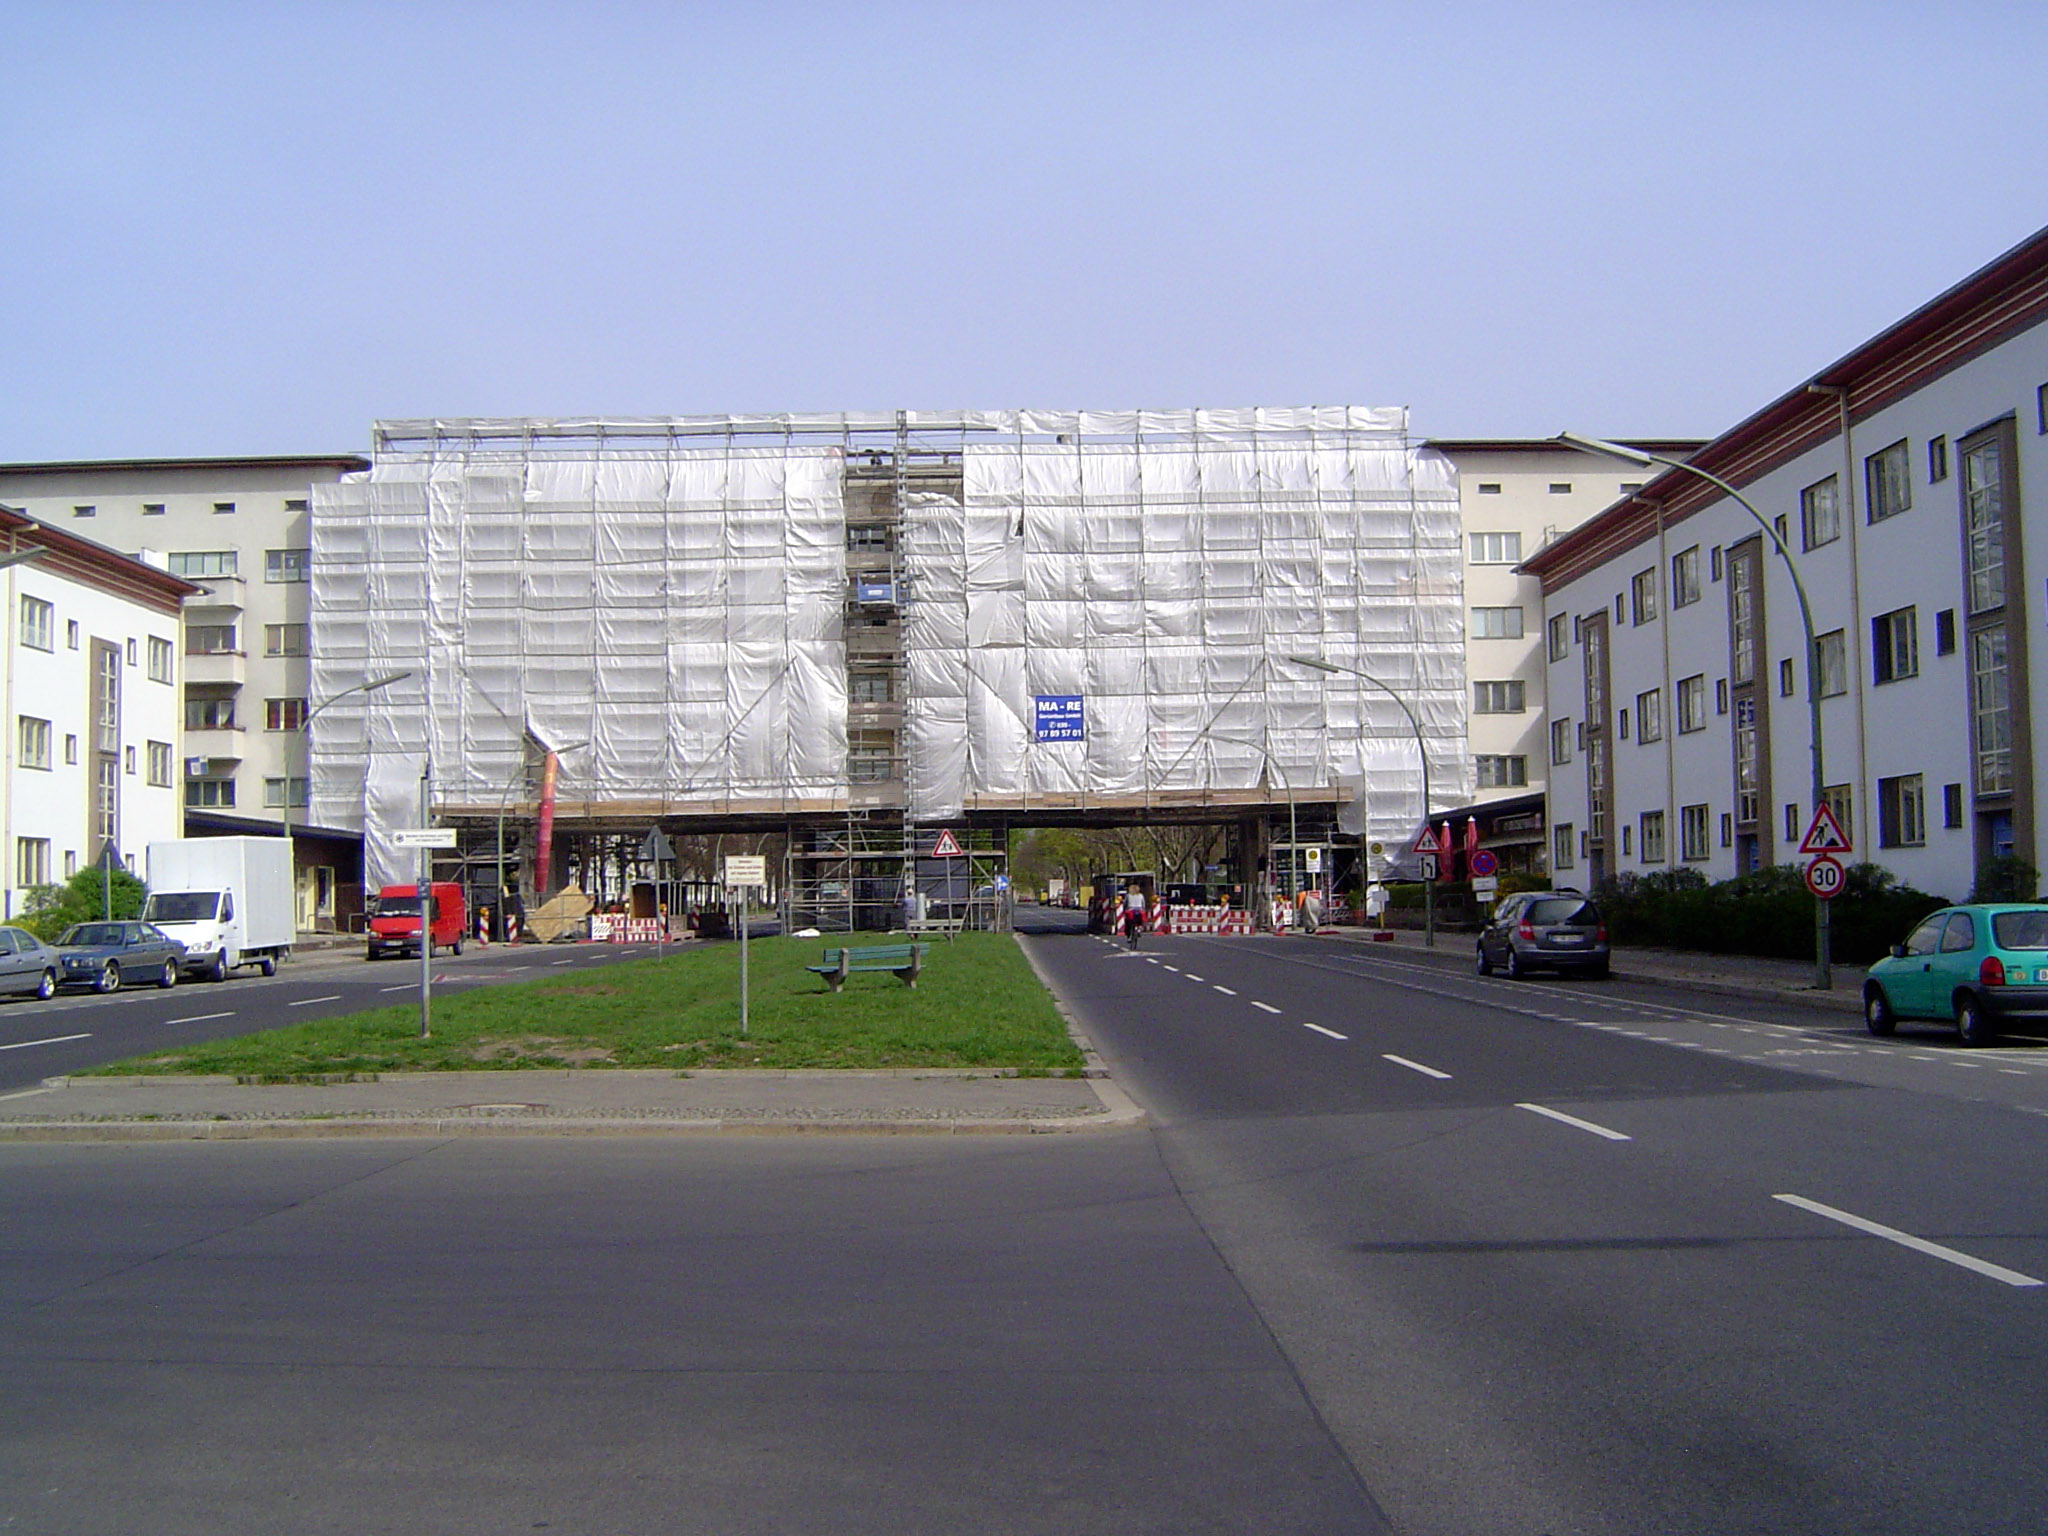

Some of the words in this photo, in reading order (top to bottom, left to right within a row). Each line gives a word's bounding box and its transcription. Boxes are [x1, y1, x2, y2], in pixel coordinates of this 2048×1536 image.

[1038, 701, 1058, 711] MA
[1066, 701, 1081, 711] RE
[1813, 867, 1836, 886] 30
